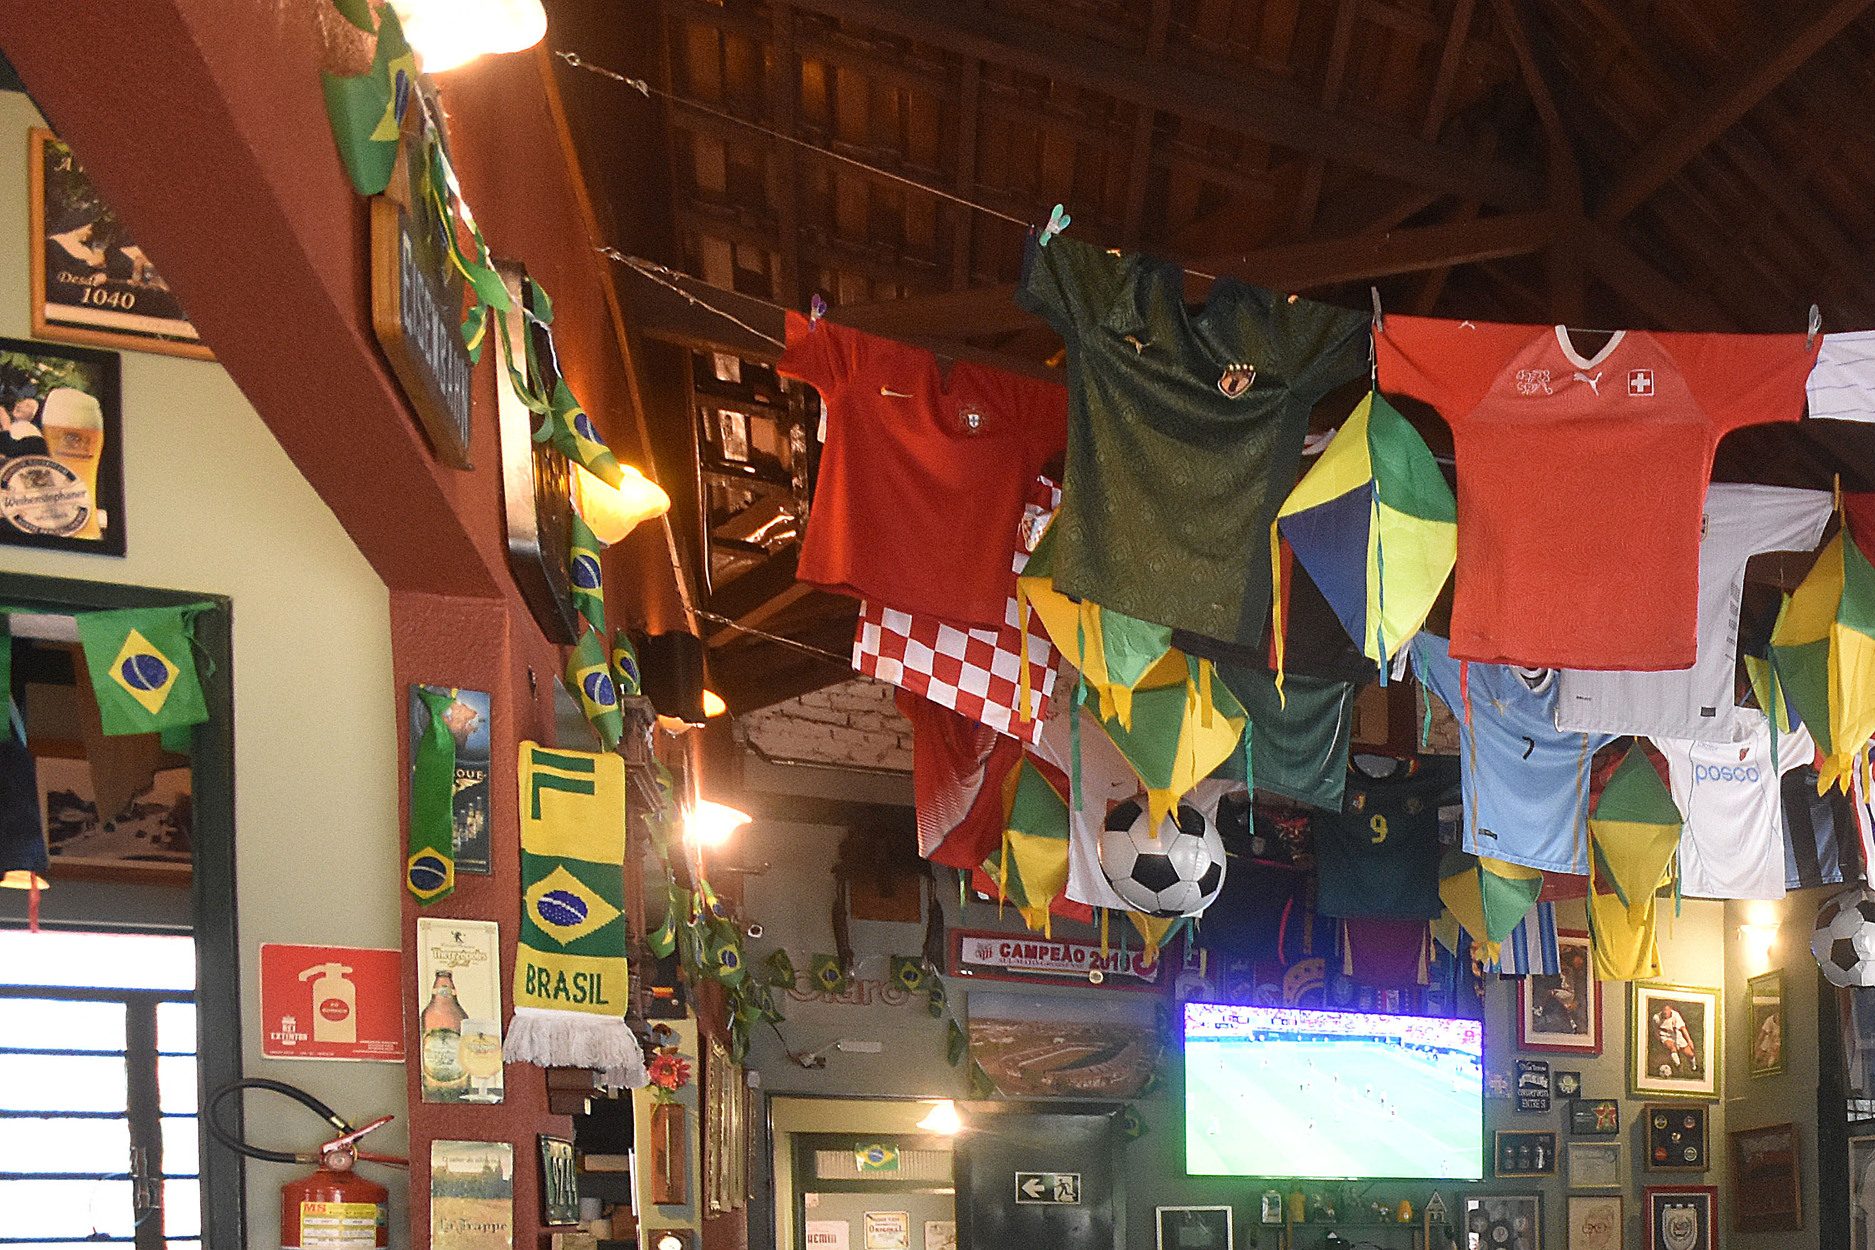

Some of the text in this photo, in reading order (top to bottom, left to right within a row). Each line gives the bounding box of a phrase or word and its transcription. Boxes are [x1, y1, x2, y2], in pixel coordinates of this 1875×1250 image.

[82, 287, 136, 309] 1040
[1521, 735, 1535, 761] 7
[1694, 763, 1760, 785] posco
[1369, 813, 1388, 844] 9
[1000, 943, 1085, 963] CAMPEÃO
[525, 963, 609, 1005] BRASIL
[304, 1203, 326, 1212] MS
